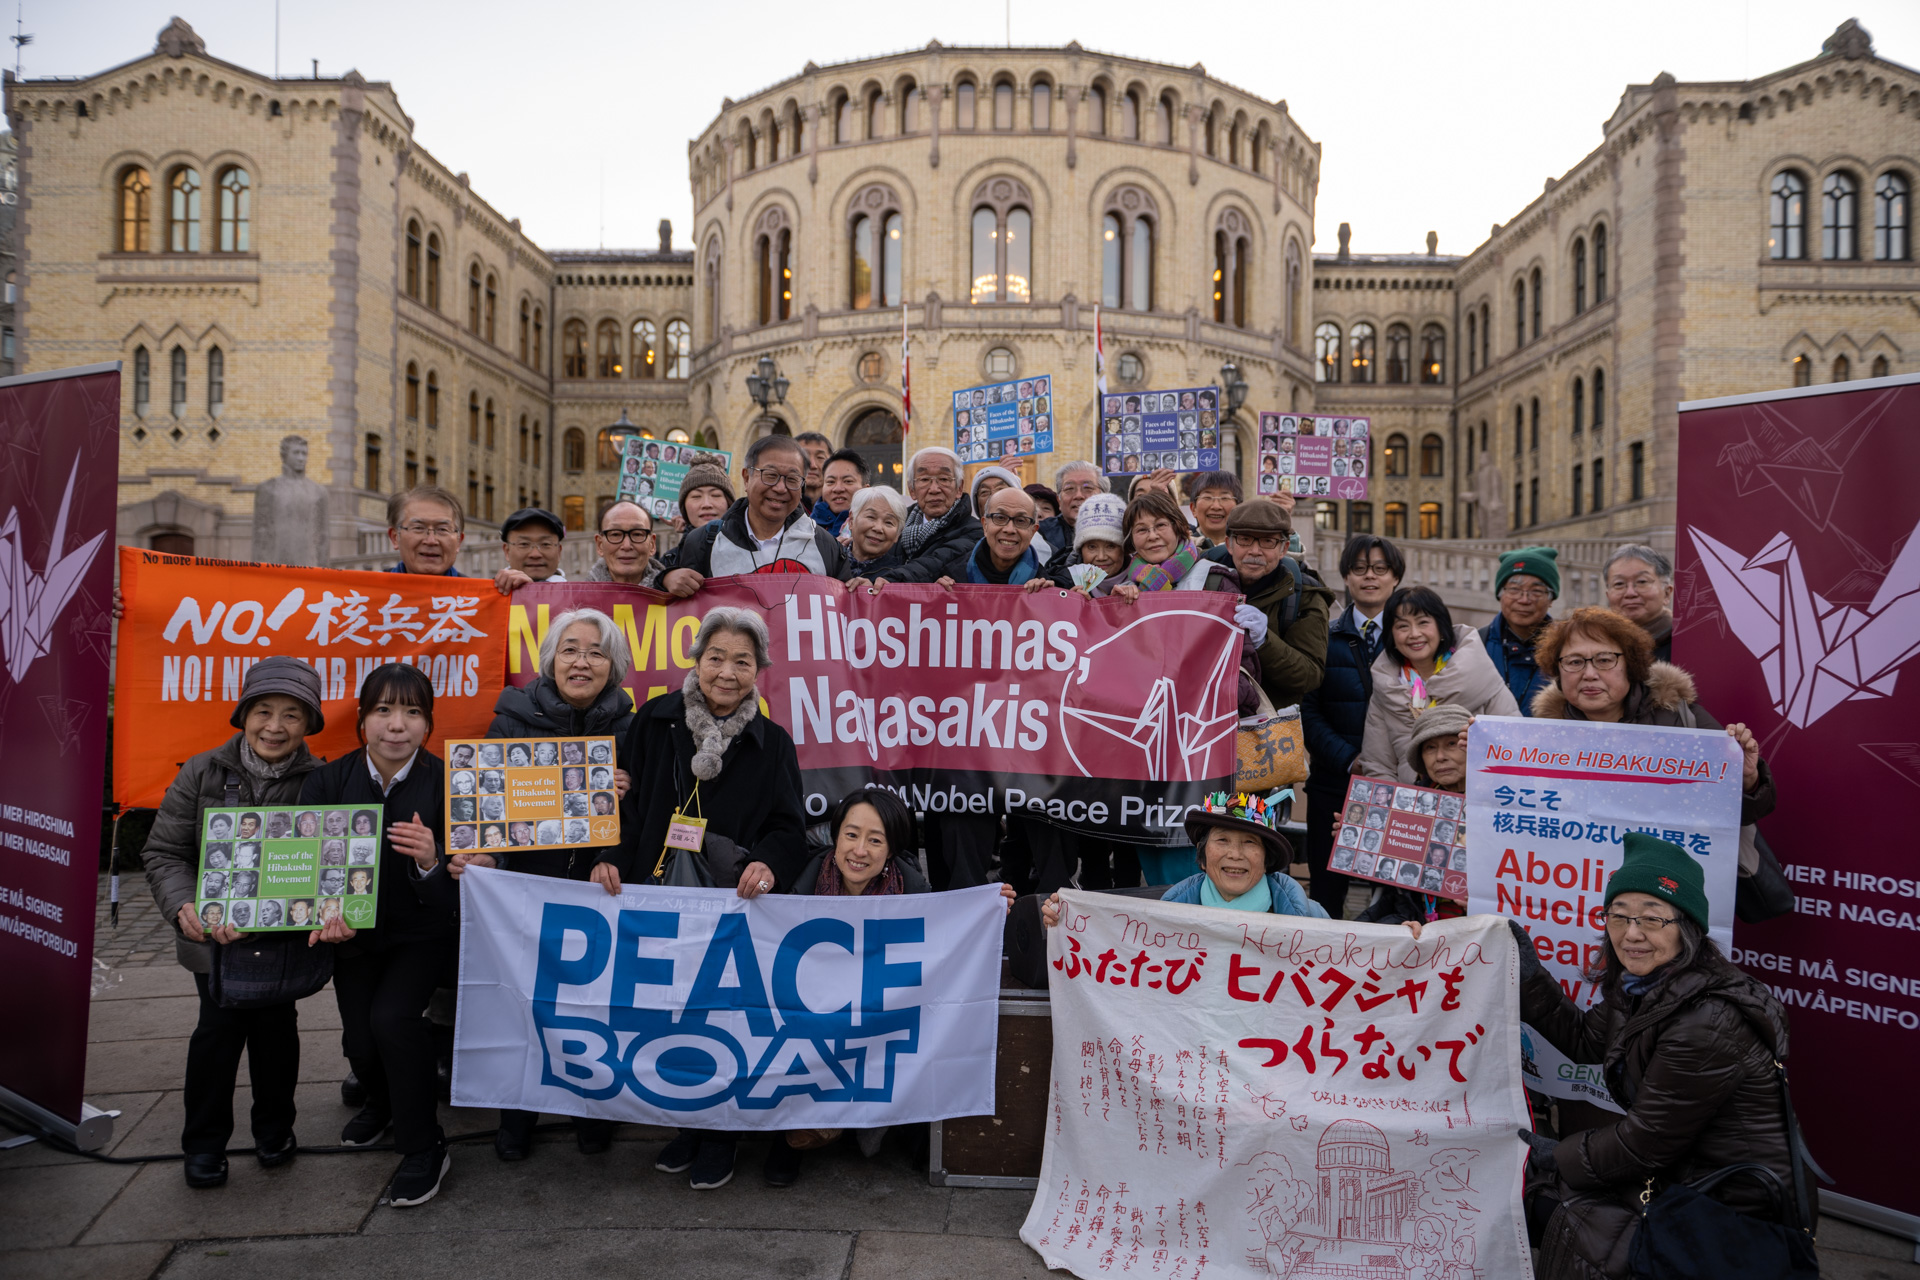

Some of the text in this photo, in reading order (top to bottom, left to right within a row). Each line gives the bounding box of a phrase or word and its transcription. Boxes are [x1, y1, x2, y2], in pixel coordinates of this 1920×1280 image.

[990, 424, 1015, 432] Movement
[143, 552, 159, 564] No
[162, 555, 191, 566] more
[163, 587, 488, 646] NO! 核兵器
[161, 655, 215, 701] NO!
[789, 676, 1049, 762] Nagasakis
[1486, 744, 1513, 762] No
[1518, 747, 1571, 766] More
[1576, 751, 1711, 778] HIBAKUSHA
[512, 778, 556, 787] Faces of the
[512, 788, 556, 797] Hibakusha
[513, 799, 556, 808] Movement
[913, 784, 995, 814] Nobel
[1005, 788, 1109, 825] Peace
[1494, 785, 1562, 811] 今こそ
[24, 809, 75, 838] HIROSHIMA
[1389, 829, 1425, 842] Hibakusha
[1391, 819, 1408, 829] Faces
[1416, 825, 1428, 833] the
[4, 833, 24, 851] MER
[25, 838, 70, 867] NAGASAKI
[268, 851, 314, 860] Faces of the
[1386, 838, 1422, 852] Movement
[266, 875, 312, 884] Movement
[267, 863, 313, 872] Hibakusha
[25, 895, 63, 923] SIGNERE
[1237, 923, 1494, 970] Hibakusha
[533, 902, 925, 1040] PEACE
[1053, 935, 1465, 1014] ふたたび ヒバクシャを
[1799, 958, 1839, 983] MÅ
[1238, 1016, 1485, 1083] つくらないで
[542, 1027, 911, 1102] BOAT
